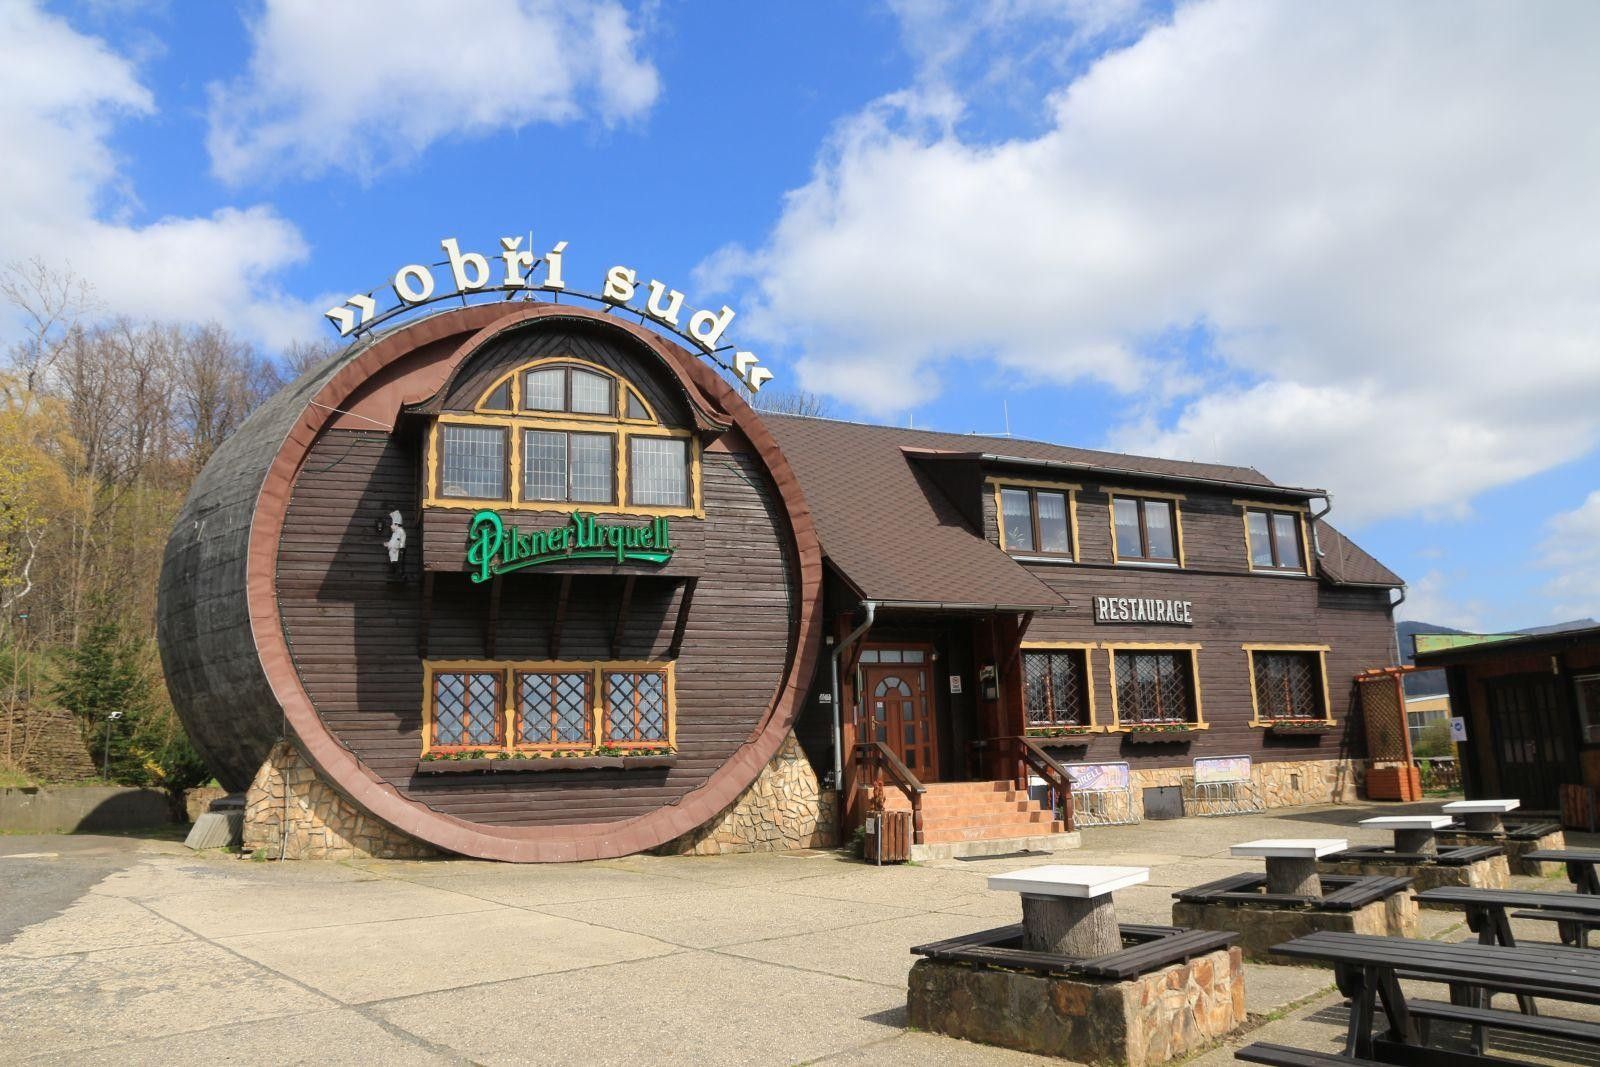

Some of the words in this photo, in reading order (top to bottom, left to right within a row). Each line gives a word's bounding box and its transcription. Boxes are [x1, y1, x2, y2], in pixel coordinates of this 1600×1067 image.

[468, 509, 574, 584] Pilsner
[572, 509, 669, 564] Urquell
[1098, 597, 1193, 623] RESTAURACE
